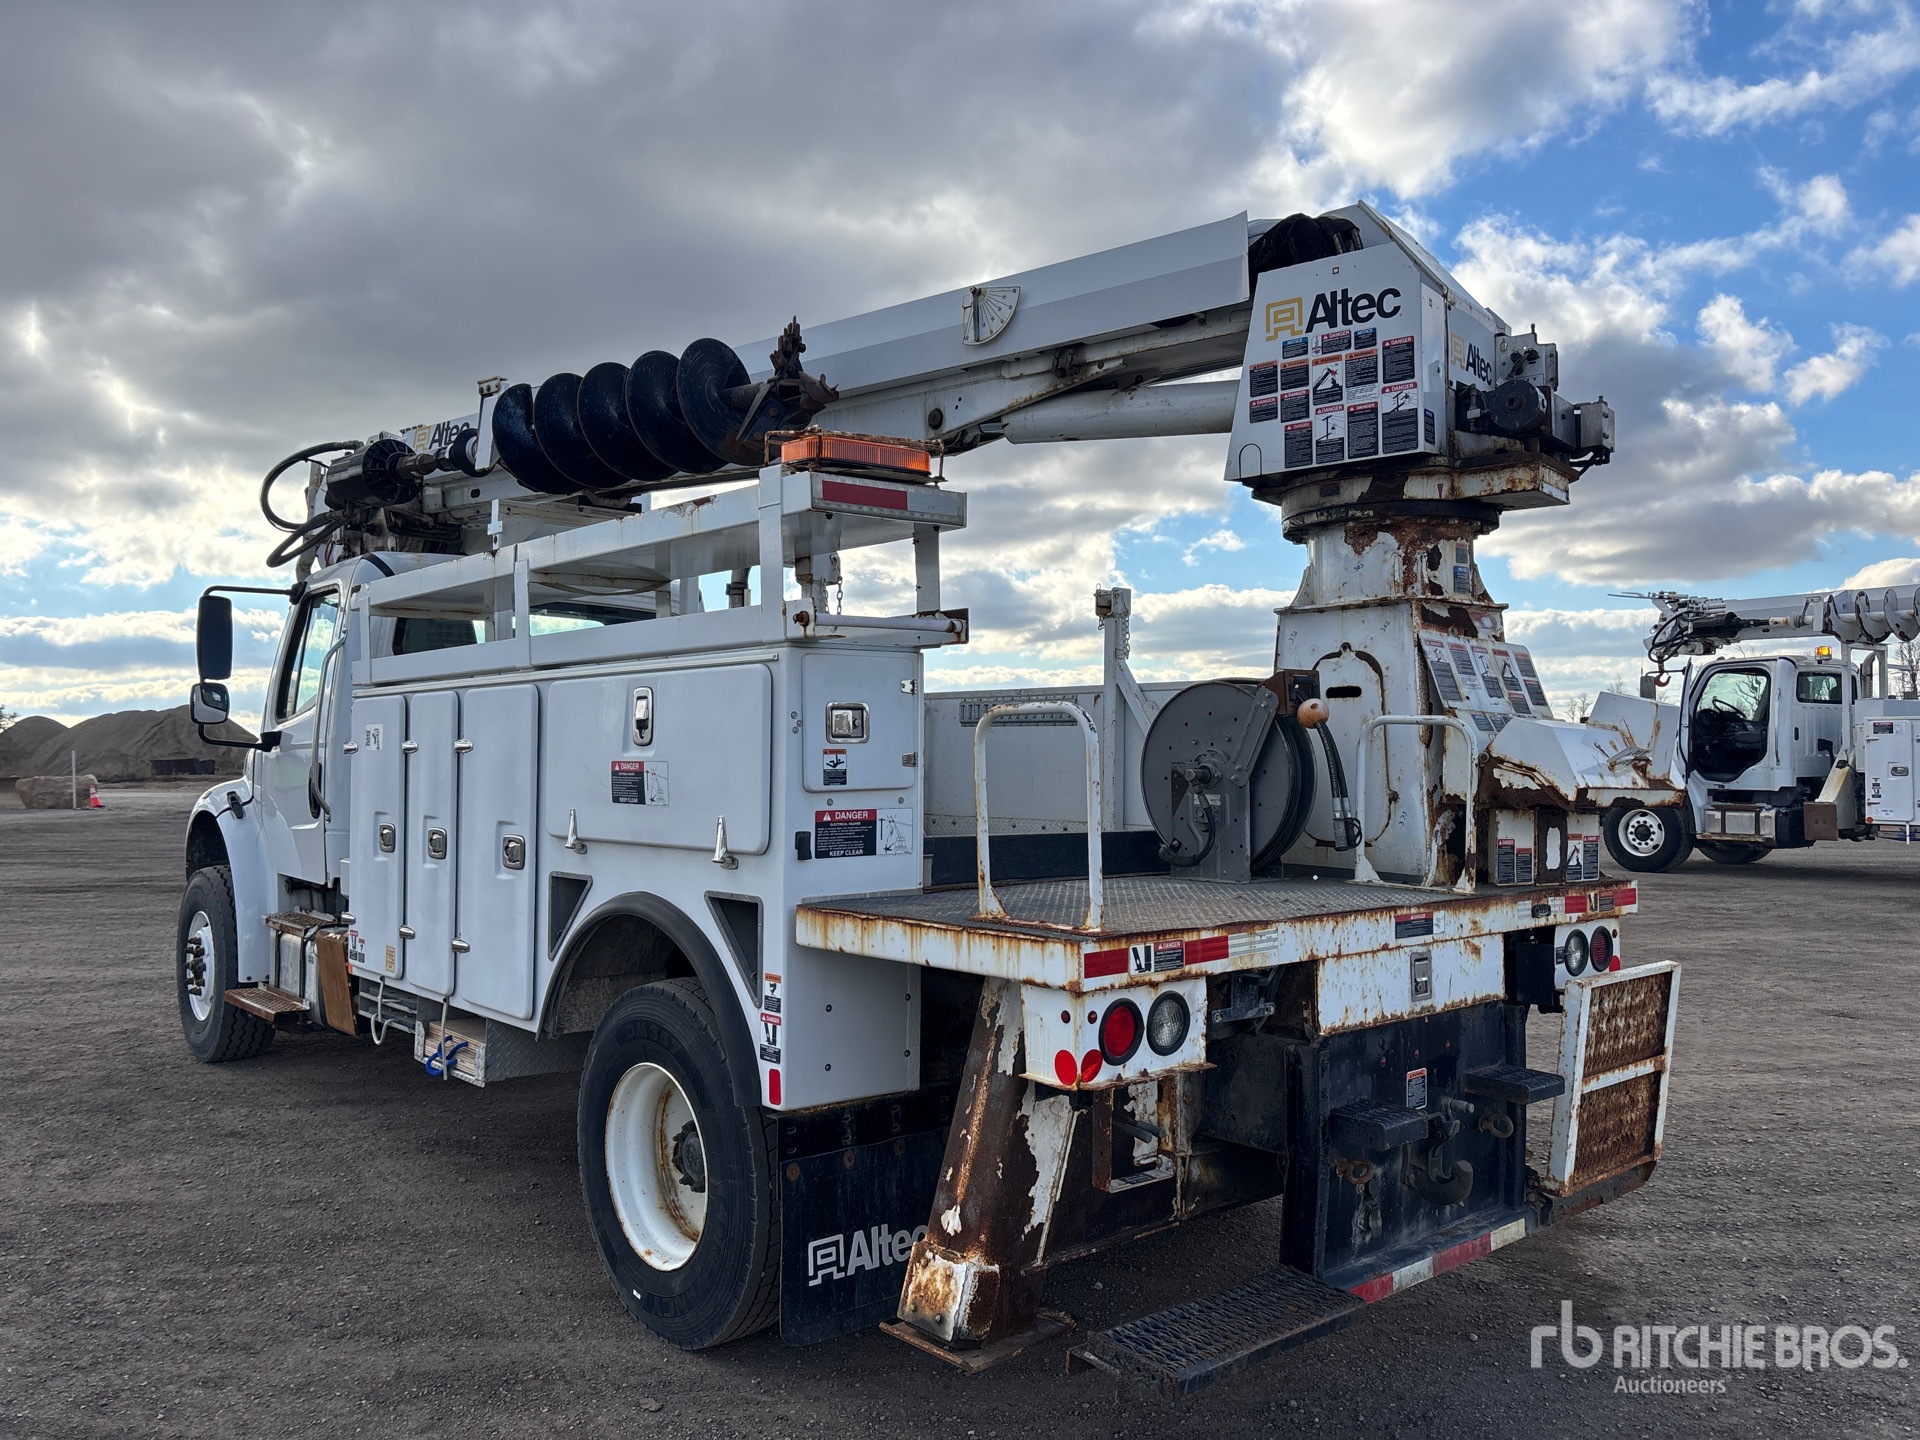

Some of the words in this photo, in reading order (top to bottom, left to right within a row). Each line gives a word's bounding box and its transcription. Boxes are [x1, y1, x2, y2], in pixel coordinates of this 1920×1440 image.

[1305, 288, 1402, 334] Altec
[1328, 330, 1350, 339] DANGER
[1390, 337, 1412, 346] DANGER
[1466, 342, 1492, 386] Altec
[1391, 383, 1414, 392] DANGER
[1322, 405, 1343, 413] DANGER
[835, 811, 869, 820] DANGER
[1162, 941, 1181, 949] DANGER
